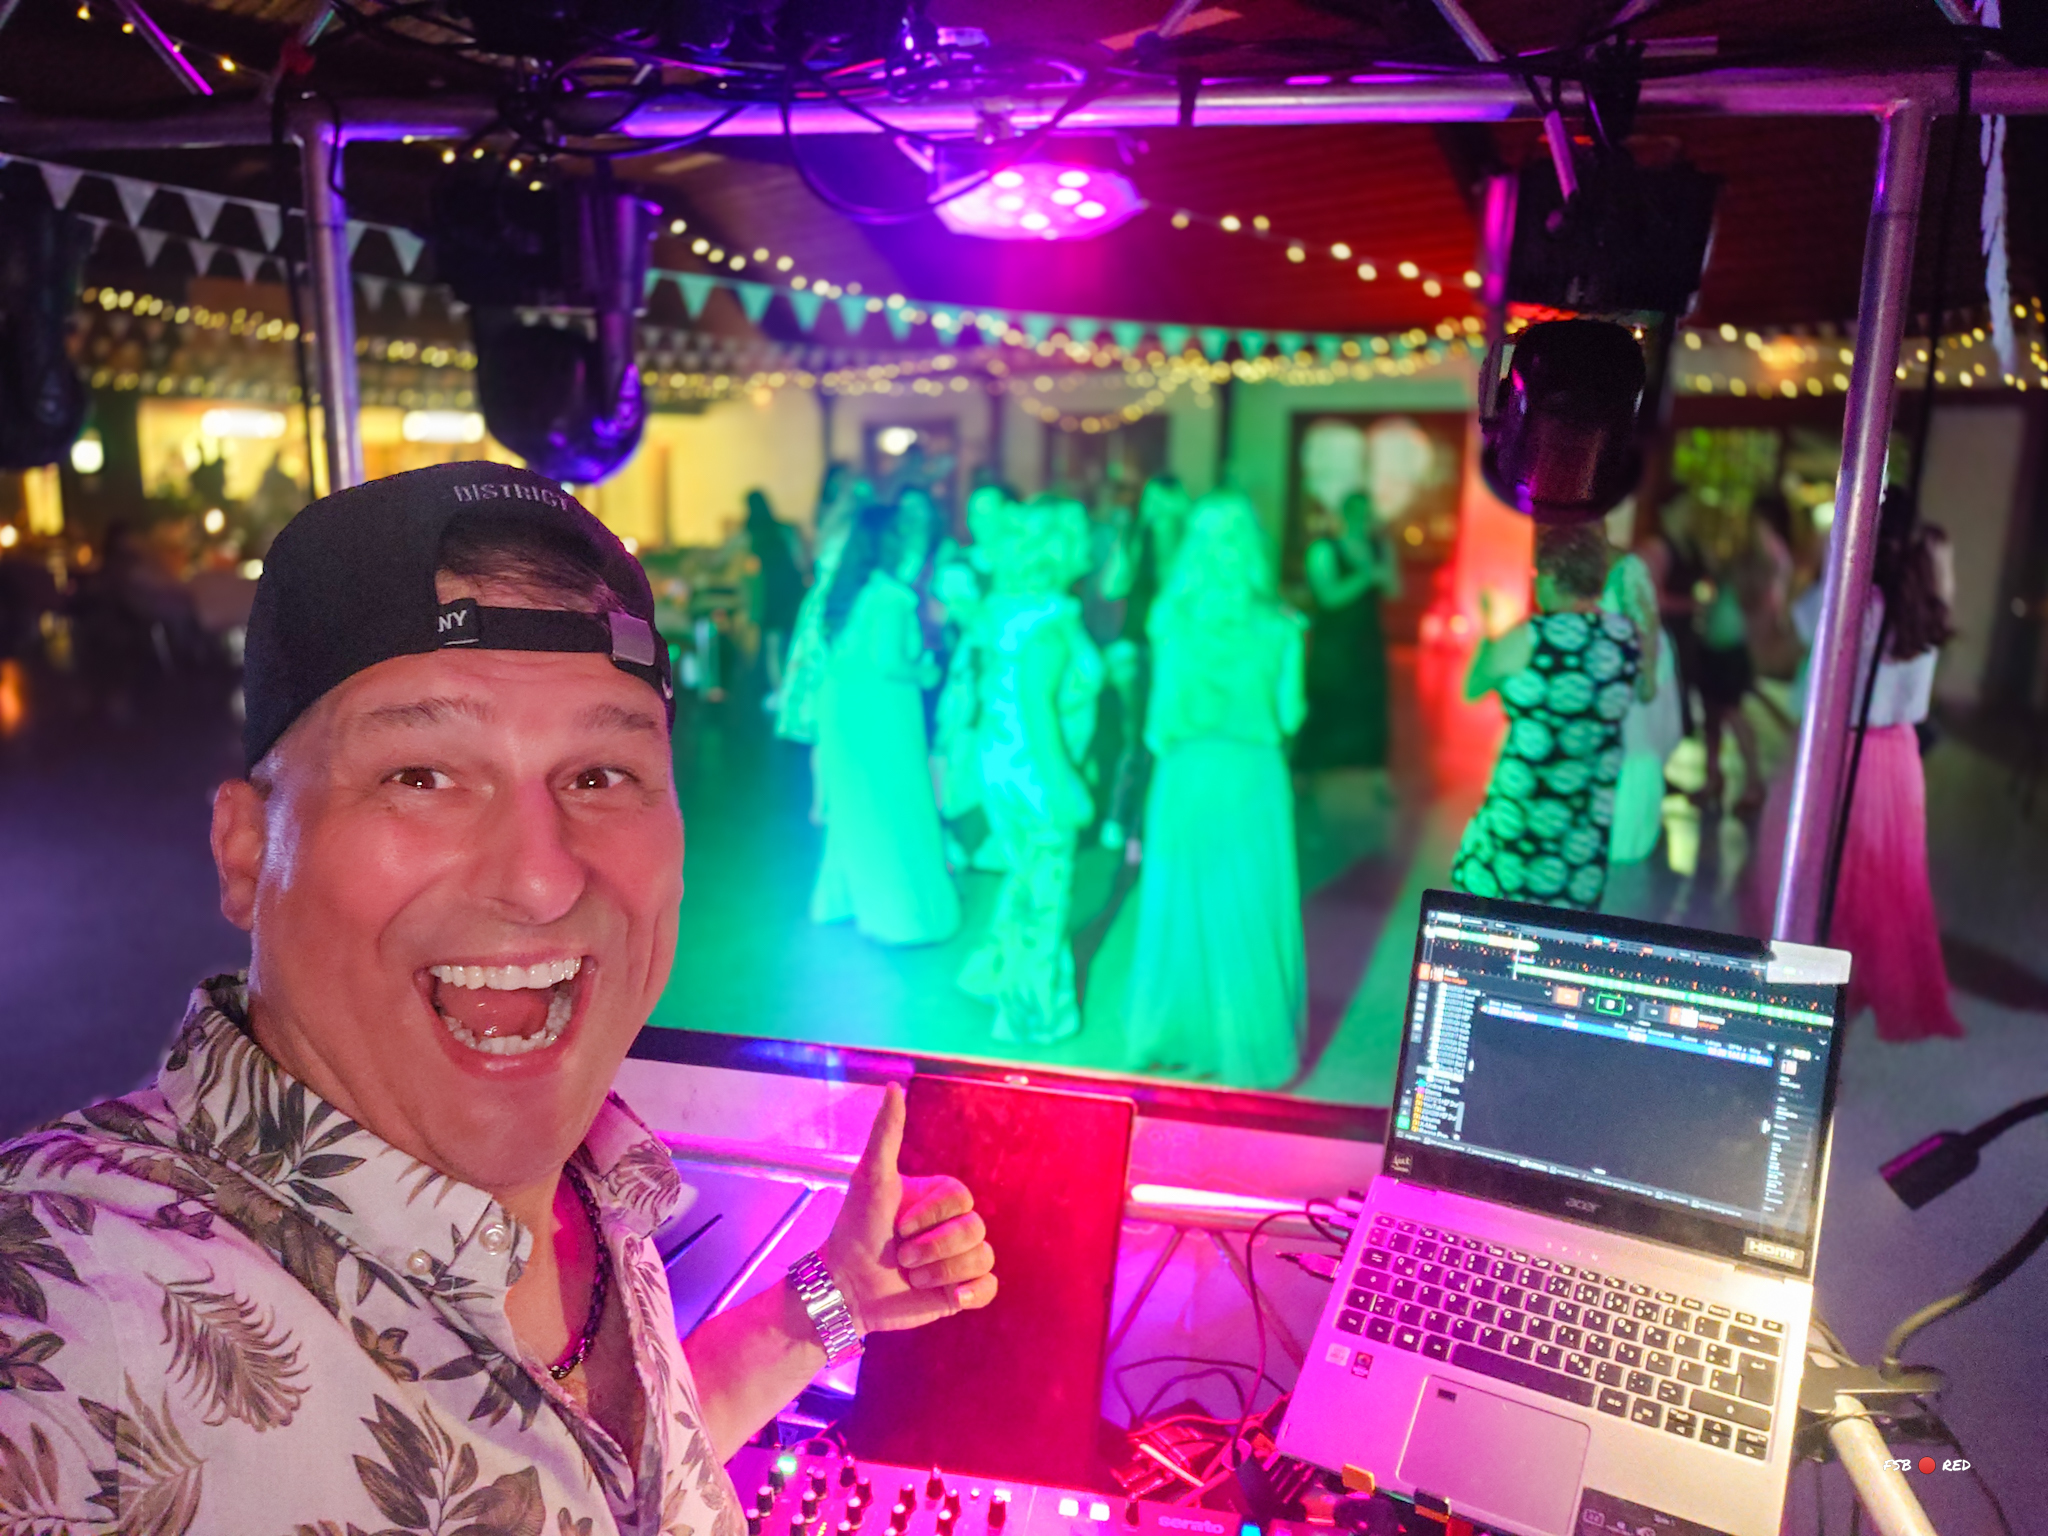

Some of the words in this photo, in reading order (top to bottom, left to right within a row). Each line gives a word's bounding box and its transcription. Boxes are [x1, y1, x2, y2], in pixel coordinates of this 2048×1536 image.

[454, 482, 569, 511] DISTRICT
[438, 609, 468, 632] NY
[1749, 1240, 1796, 1261] HDMI
[1157, 1515, 1225, 1535] serato
